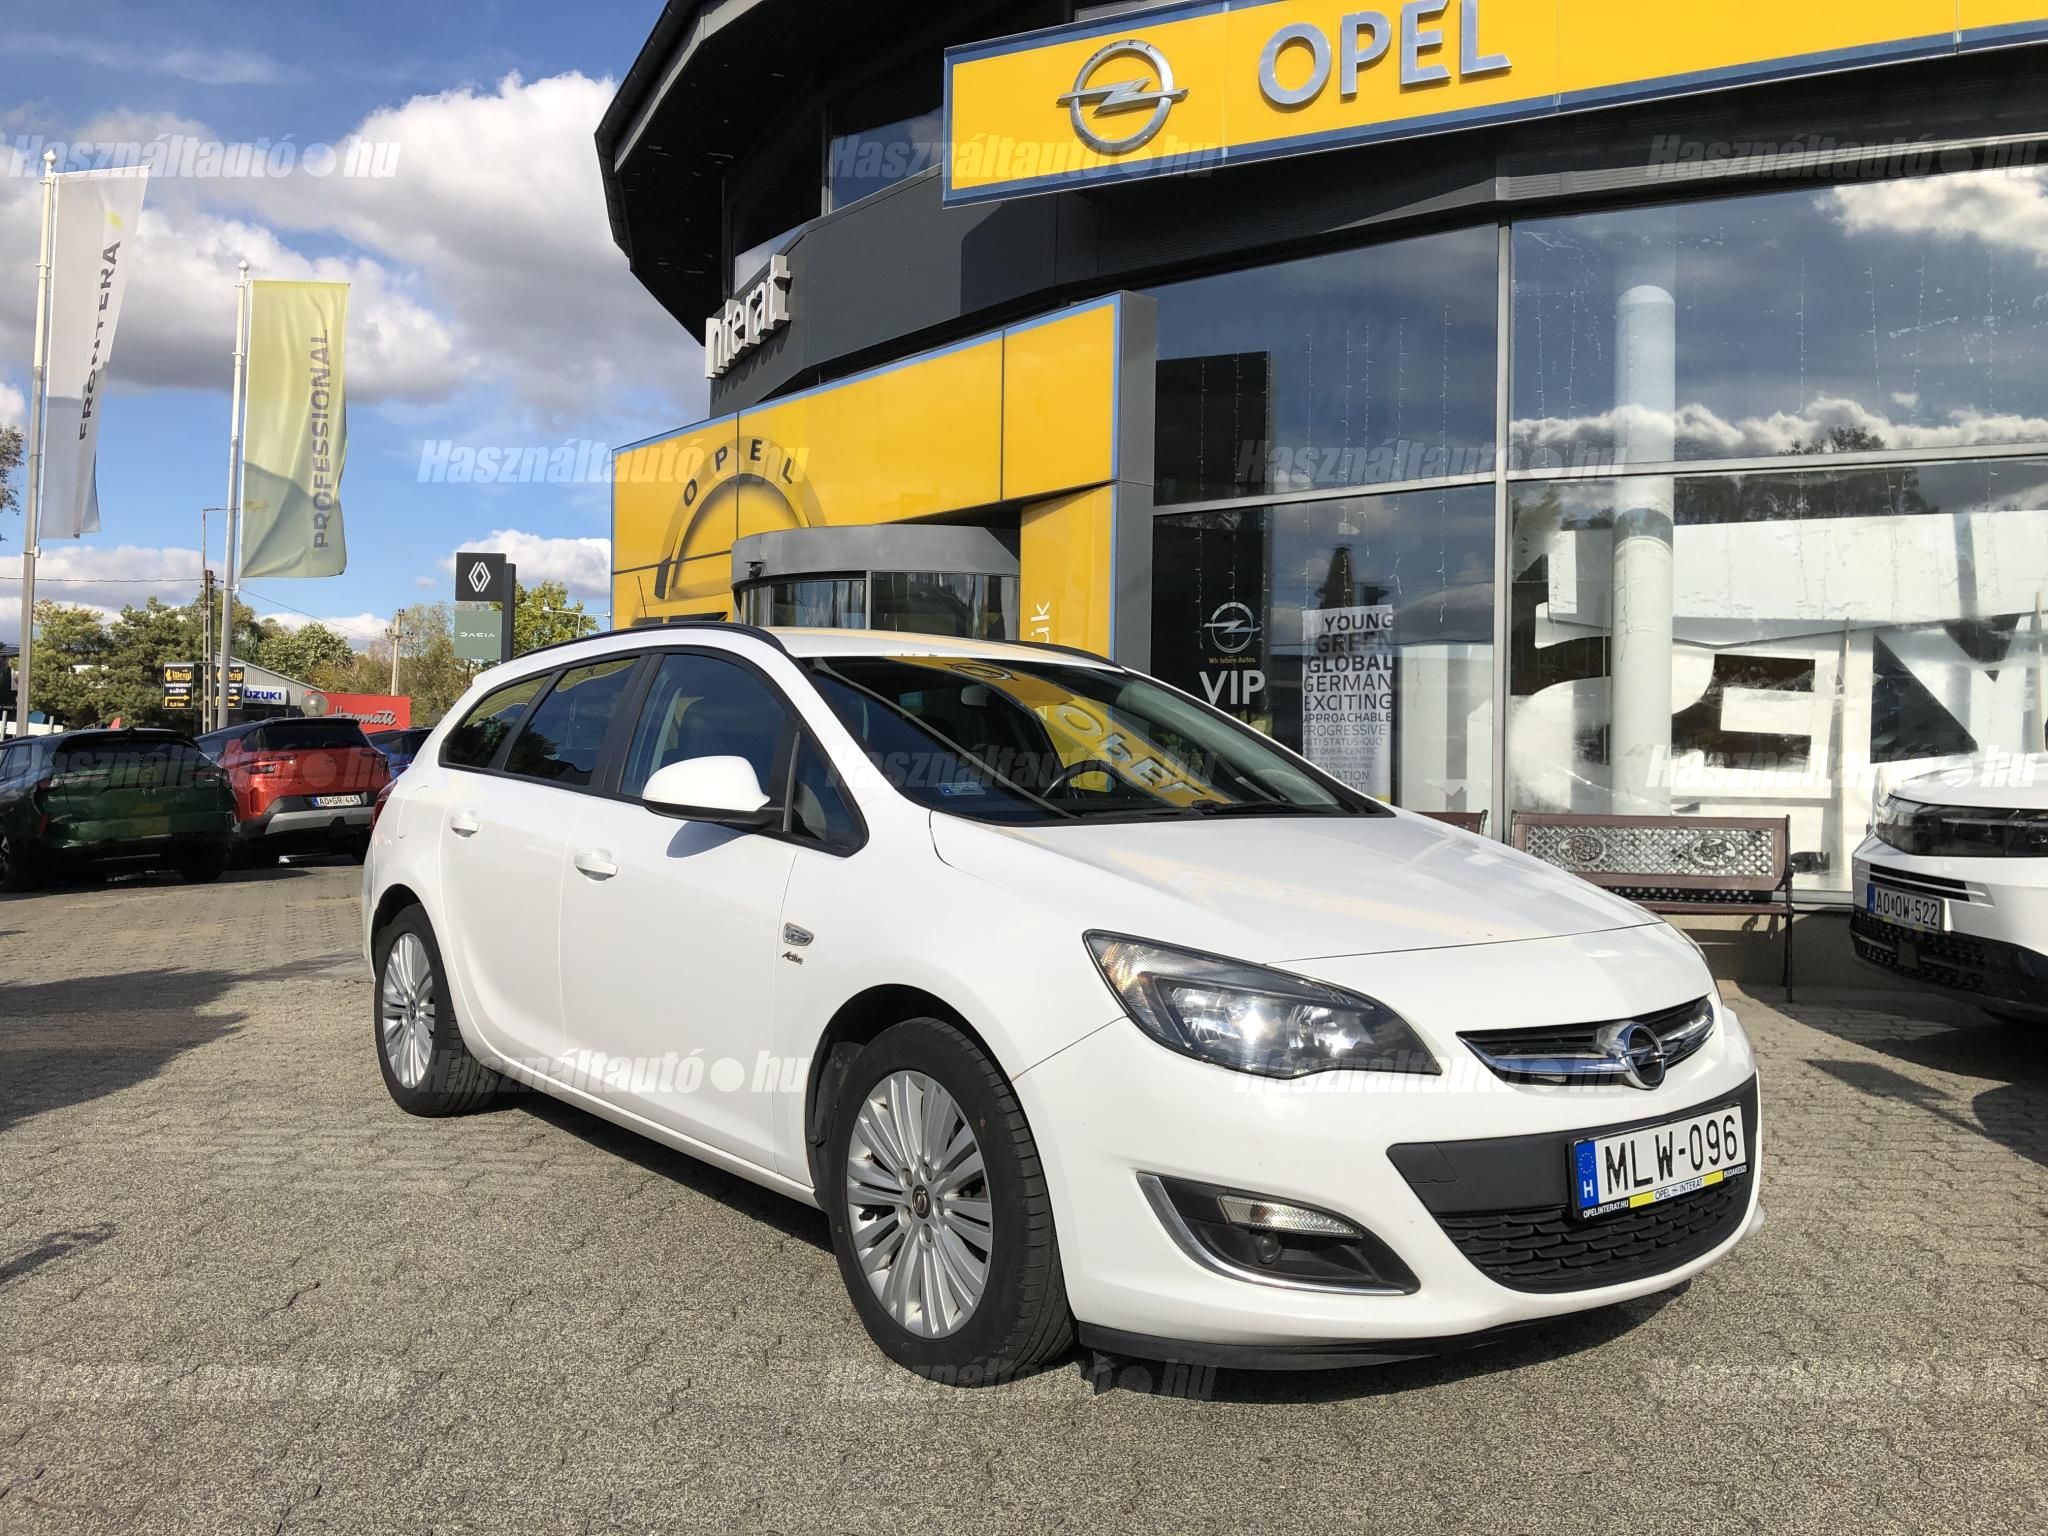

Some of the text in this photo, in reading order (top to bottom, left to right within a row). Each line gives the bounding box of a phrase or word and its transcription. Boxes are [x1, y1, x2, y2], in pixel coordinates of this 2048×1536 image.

[1259, 0, 1512, 104] OPEL
[310, 329, 331, 548] PROFESSIONAL
[684, 438, 793, 507] OPEL
[1325, 613, 1393, 632] YOUNG
[1308, 653, 1392, 673] GLOBAL
[1199, 669, 1266, 706] VIP
[1303, 673, 1392, 693] GERMAN
[244, 689, 282, 700] UZUKI
[1304, 693, 1392, 711] EXCITING
[1304, 724, 1387, 737] PROGRESSIVE
[1604, 1115, 1737, 1194] MLW-096
[1583, 1179, 1594, 1199] H
[1655, 1177, 1704, 1200] OPEL INTERAT
